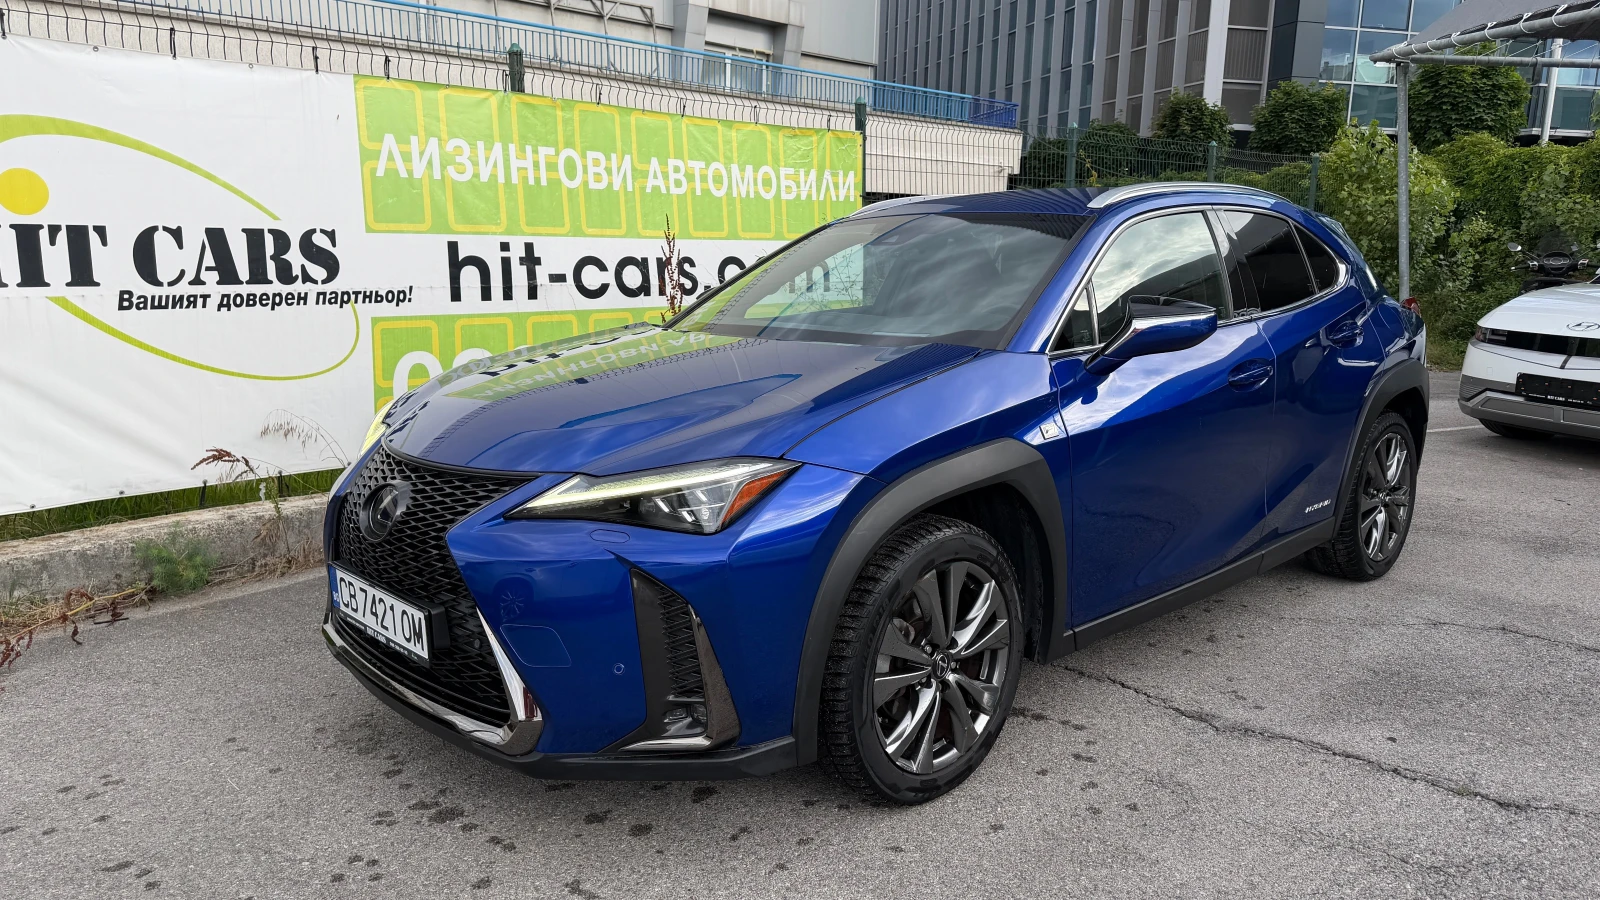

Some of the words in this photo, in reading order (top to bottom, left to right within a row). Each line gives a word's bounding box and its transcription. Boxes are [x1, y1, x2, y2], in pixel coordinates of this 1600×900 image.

[375, 132, 634, 193] ЛИЗИНГОВИ
[645, 156, 856, 203] АВТОМОБИЛИ
[0, 224, 108, 288] IT
[132, 225, 341, 288] CARS
[117, 288, 212, 312] Вашият
[216, 289, 309, 312] доверен
[314, 285, 414, 308] партньор!
[339, 576, 359, 614] CB
[359, 586, 398, 638] 7421
[401, 608, 425, 652] OM
